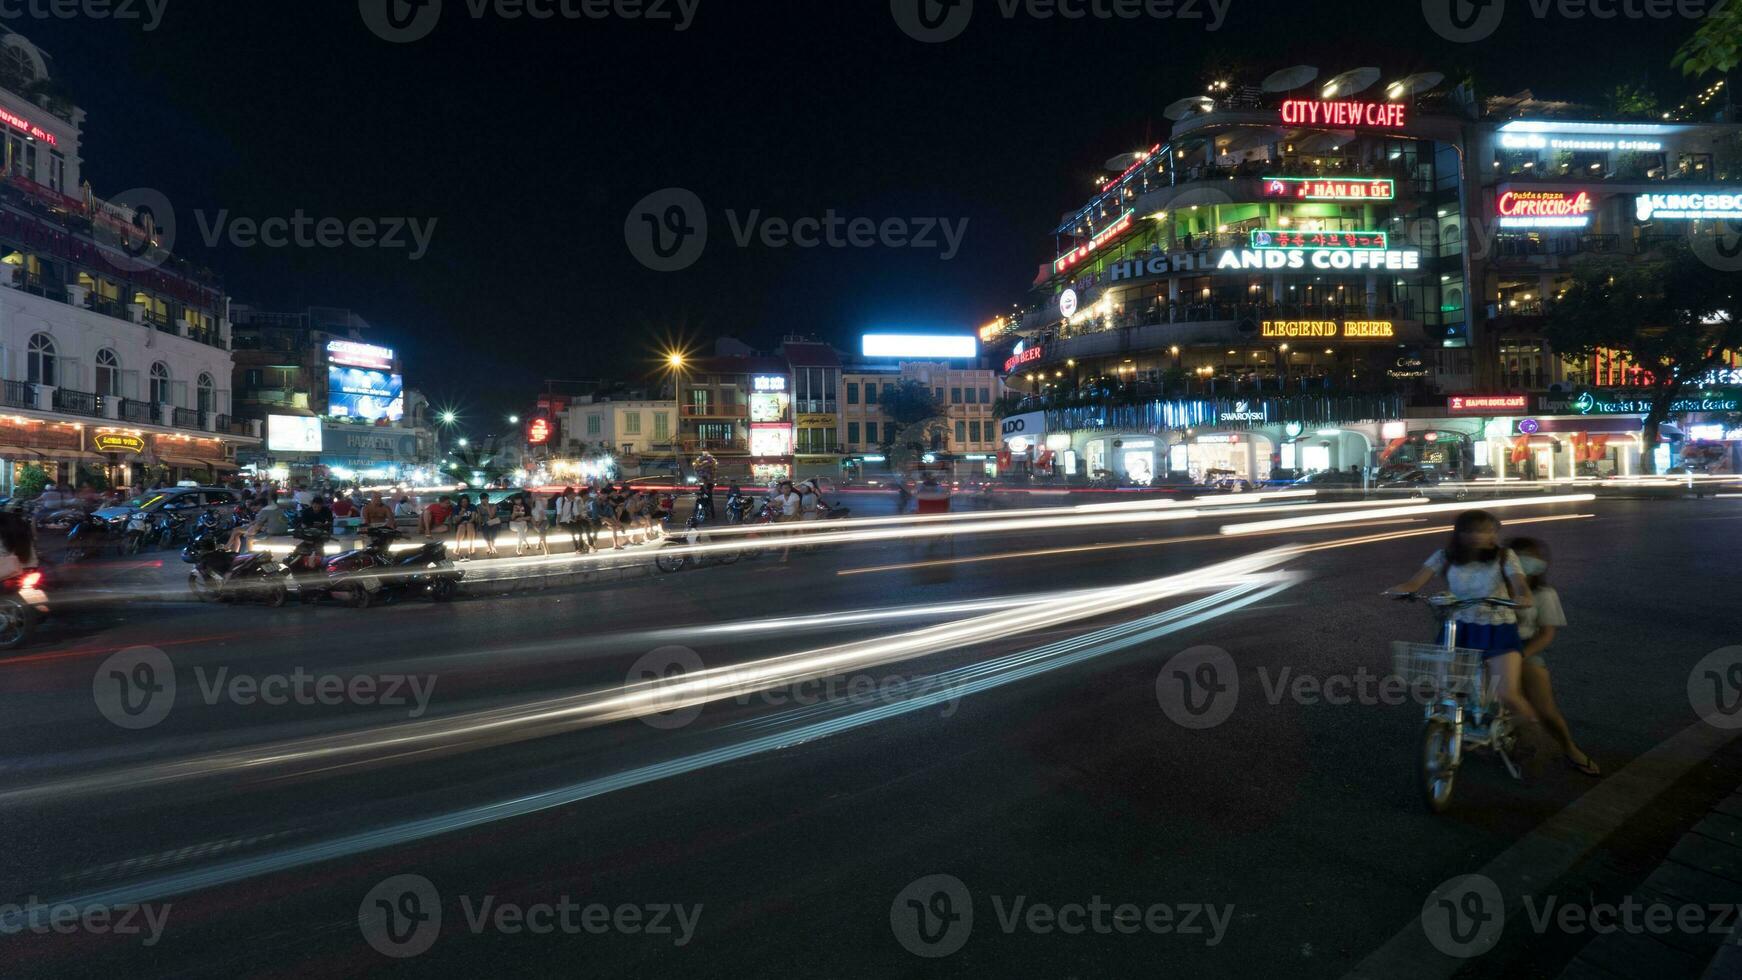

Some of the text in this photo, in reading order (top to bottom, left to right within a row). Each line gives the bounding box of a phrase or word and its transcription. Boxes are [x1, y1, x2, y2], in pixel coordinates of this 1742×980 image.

[1282, 100, 1405, 126] CITY VIEW CAFE
[0, 109, 29, 131] urant
[31, 127, 45, 140] 4th
[1314, 181, 1346, 197] HÀN
[1110, 249, 1305, 281] HIGHLANDS
[1311, 250, 1419, 269] COFFEE
[1262, 321, 1393, 337] LEGEND BEER
[1020, 346, 1041, 363] BEER
[1220, 412, 1264, 421] SWAROVSKI
